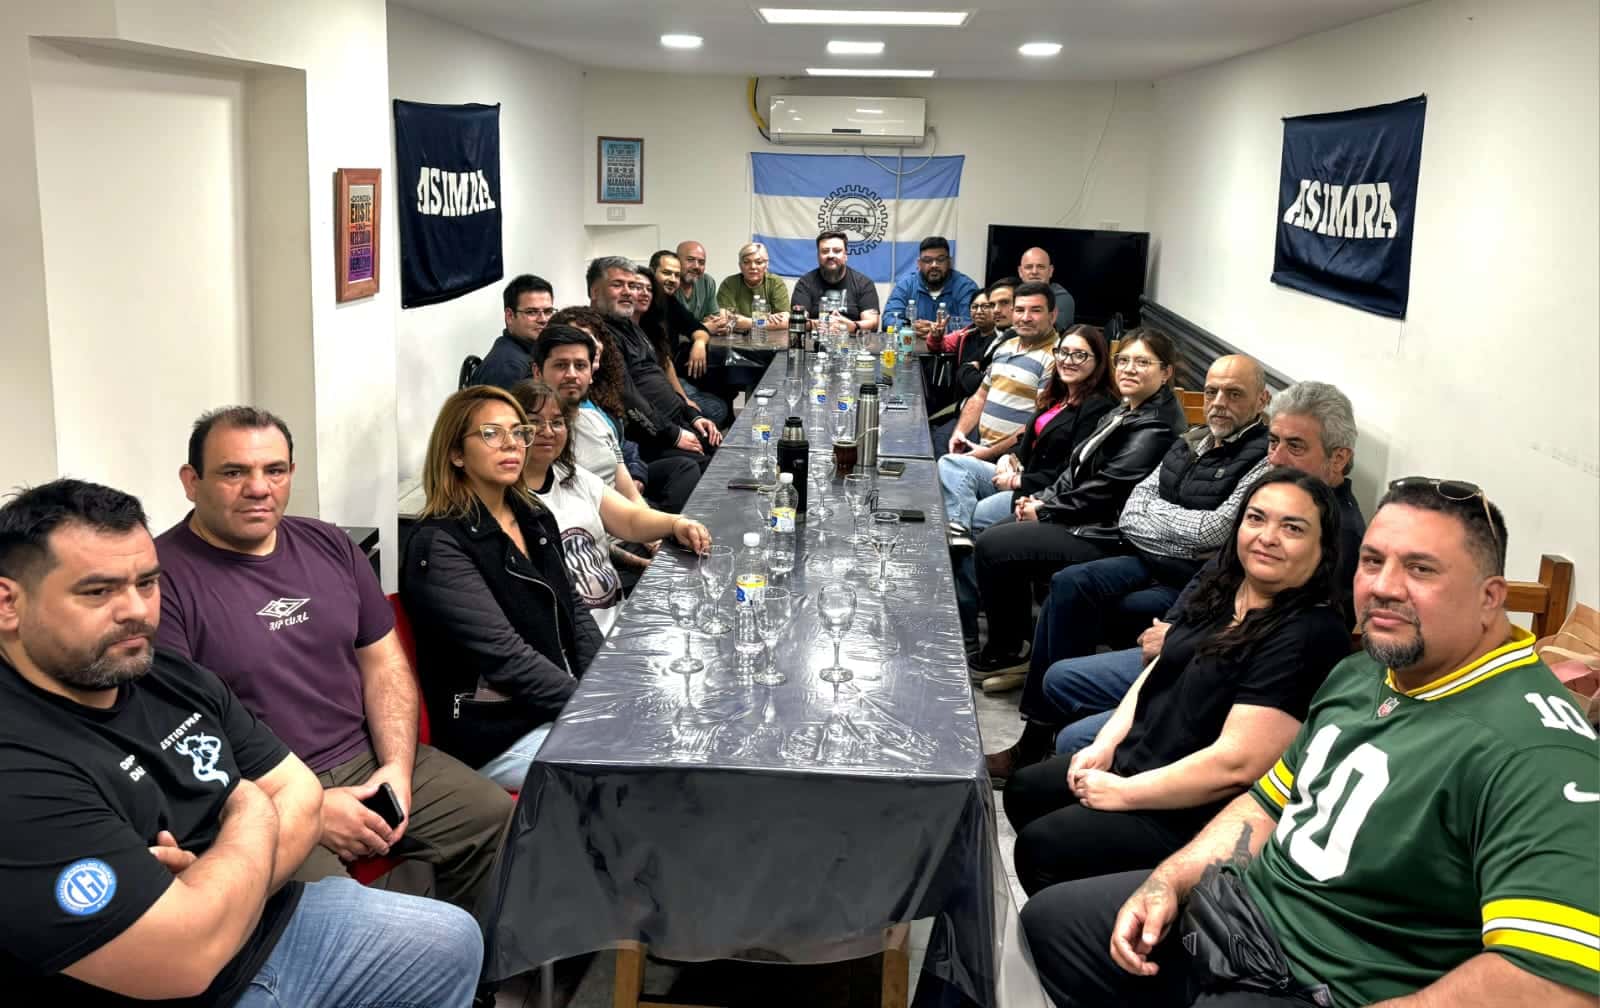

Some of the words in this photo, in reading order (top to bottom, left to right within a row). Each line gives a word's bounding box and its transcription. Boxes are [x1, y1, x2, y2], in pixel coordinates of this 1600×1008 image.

[836, 216, 870, 225] ASIMRA
[1283, 179, 1398, 239] ASIMRA
[1524, 693, 1597, 740] 10
[1276, 724, 1390, 882] 10
